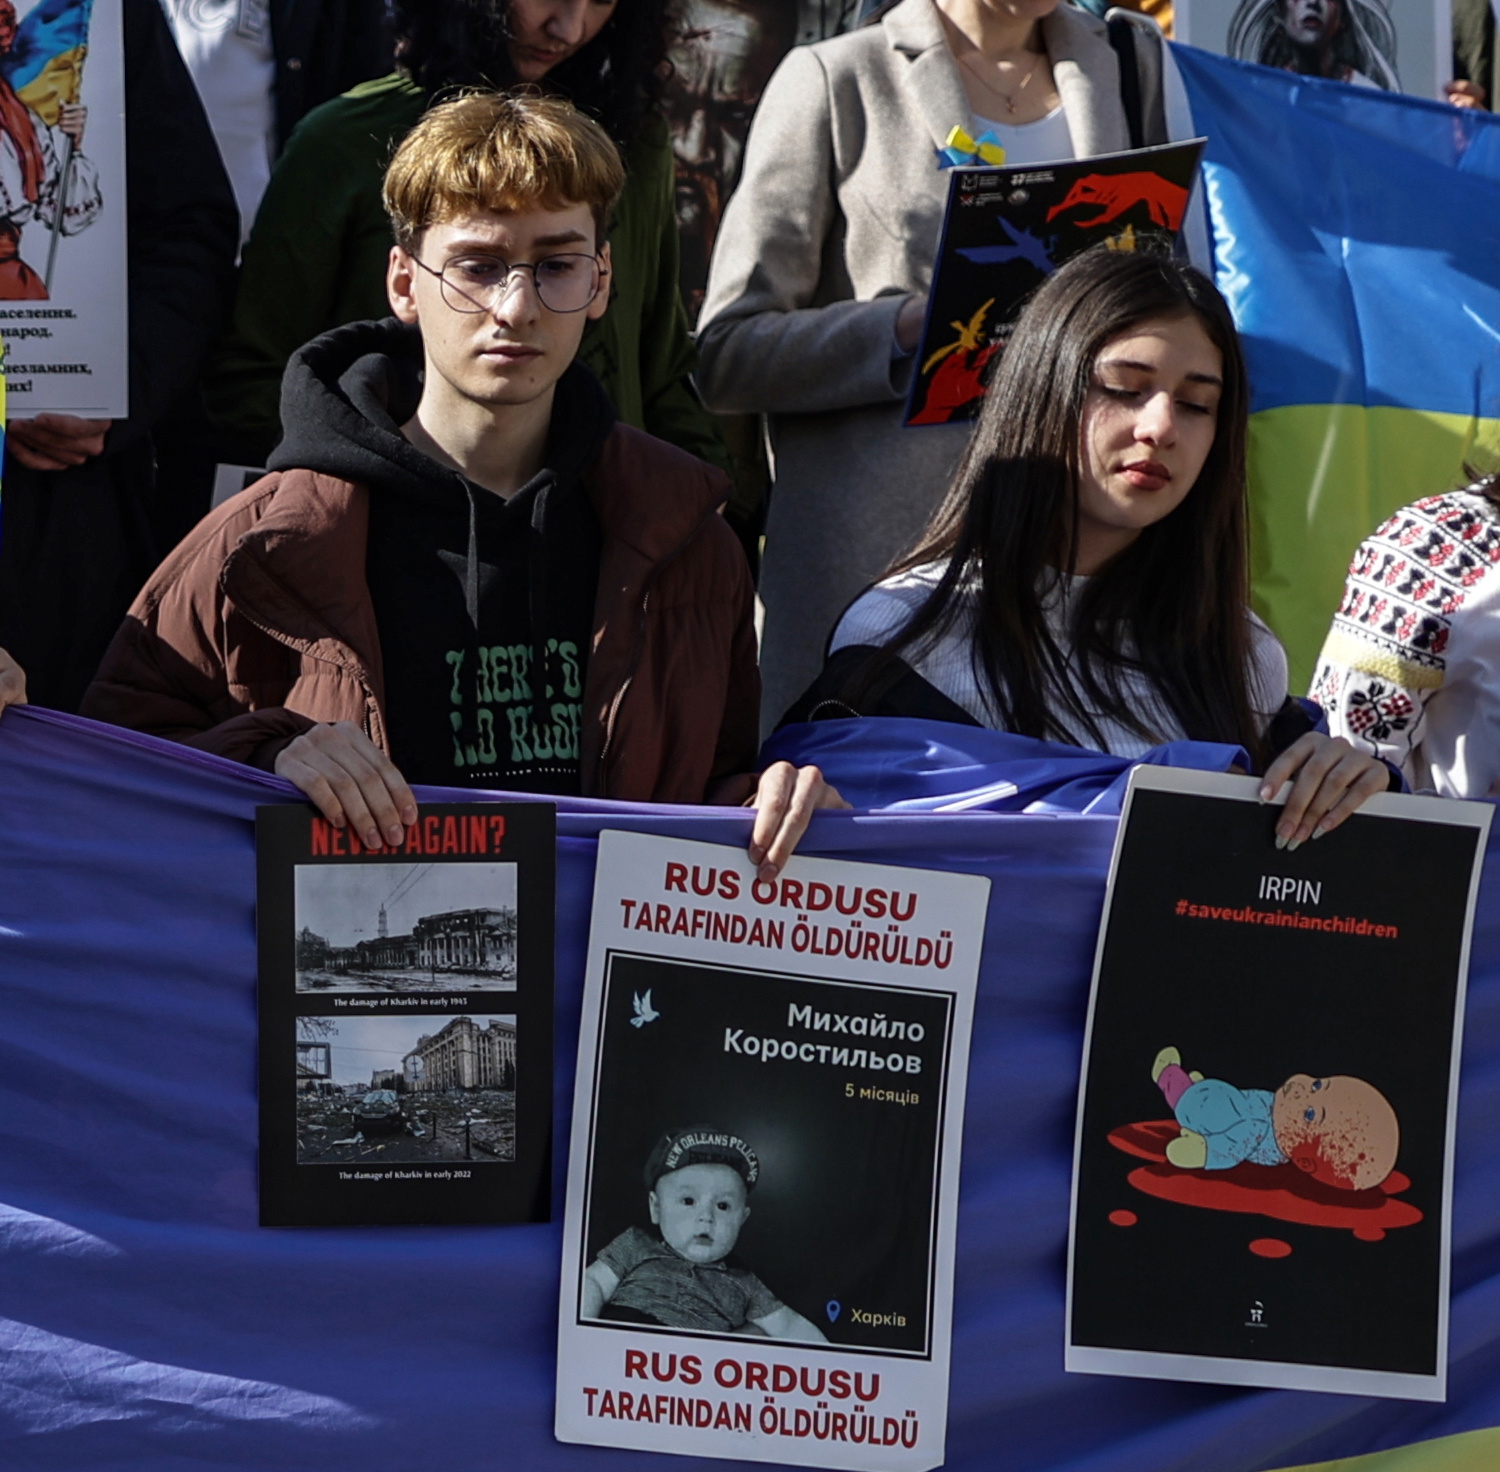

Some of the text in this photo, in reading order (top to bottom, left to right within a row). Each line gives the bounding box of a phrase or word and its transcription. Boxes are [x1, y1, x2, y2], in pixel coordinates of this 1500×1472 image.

[0, 327, 53, 339] народ.
[404, 815, 505, 855] AGAIN?
[664, 862, 918, 922] RUS ORDUSU
[1258, 875, 1322, 905] IRPIN
[620, 898, 954, 970] TARAFINDAN ÖLDÜRÜLDÜ
[1175, 899, 1398, 938] #saveukrainianchildren
[333, 998, 348, 1007] The
[349, 998, 379, 1008] damage
[380, 997, 389, 1007] of
[390, 997, 419, 1006] Kharkiv
[420, 997, 428, 1006] in
[430, 997, 448, 1008] early
[787, 1002, 925, 1042] Михайло
[723, 1027, 923, 1074] Коростильов
[845, 1083, 920, 1107] 5 місяців
[665, 1142, 684, 1169] NEW
[680, 1132, 729, 1150] ORLEANS
[339, 1170, 472, 1181] The damage of Kharkiv in early 2022
[850, 1307, 907, 1328] Харків
[624, 1349, 881, 1402] RUS ORDUSU
[583, 1387, 919, 1449] TARAFINDAN ÖLDÜRÜLDÜ
